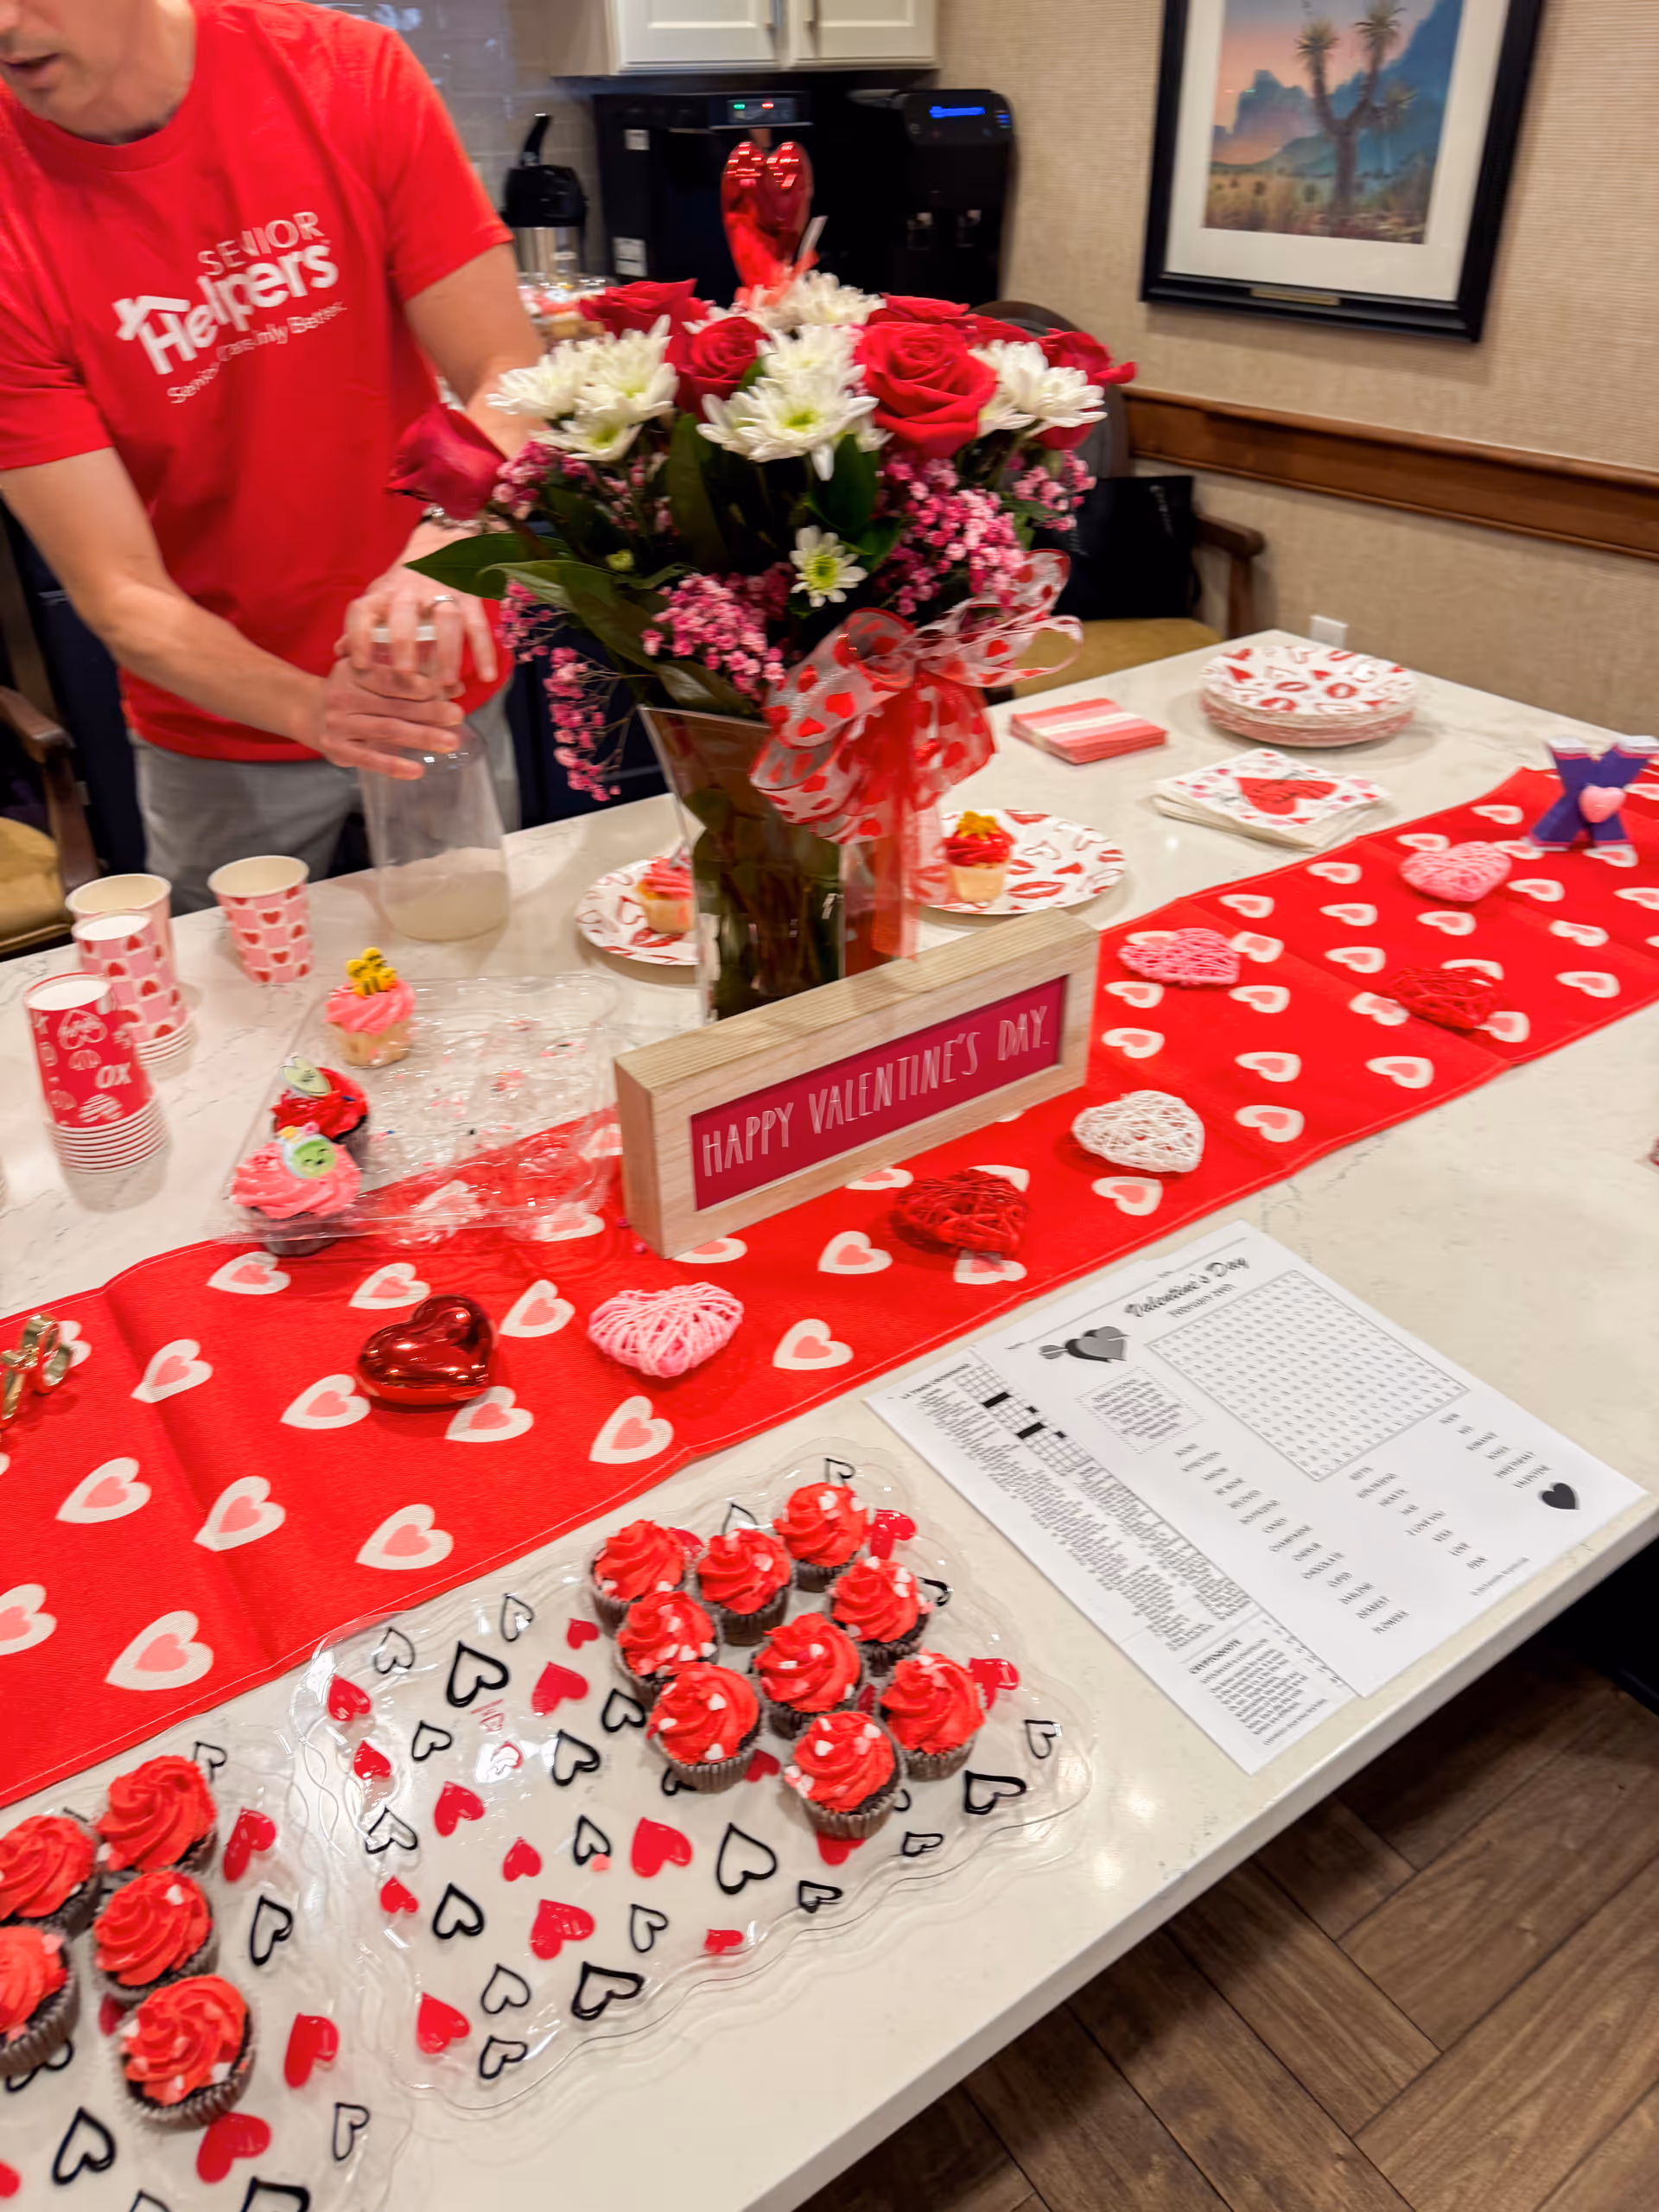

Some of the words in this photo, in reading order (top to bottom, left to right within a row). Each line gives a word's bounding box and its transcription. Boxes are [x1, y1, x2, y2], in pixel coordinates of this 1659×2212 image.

[112, 245, 340, 375] Helpers
[702, 1102, 795, 1177] HAPPY
[808, 1032, 982, 1135] VALENTINE'S
[1209, 1255, 1251, 1283] Day
